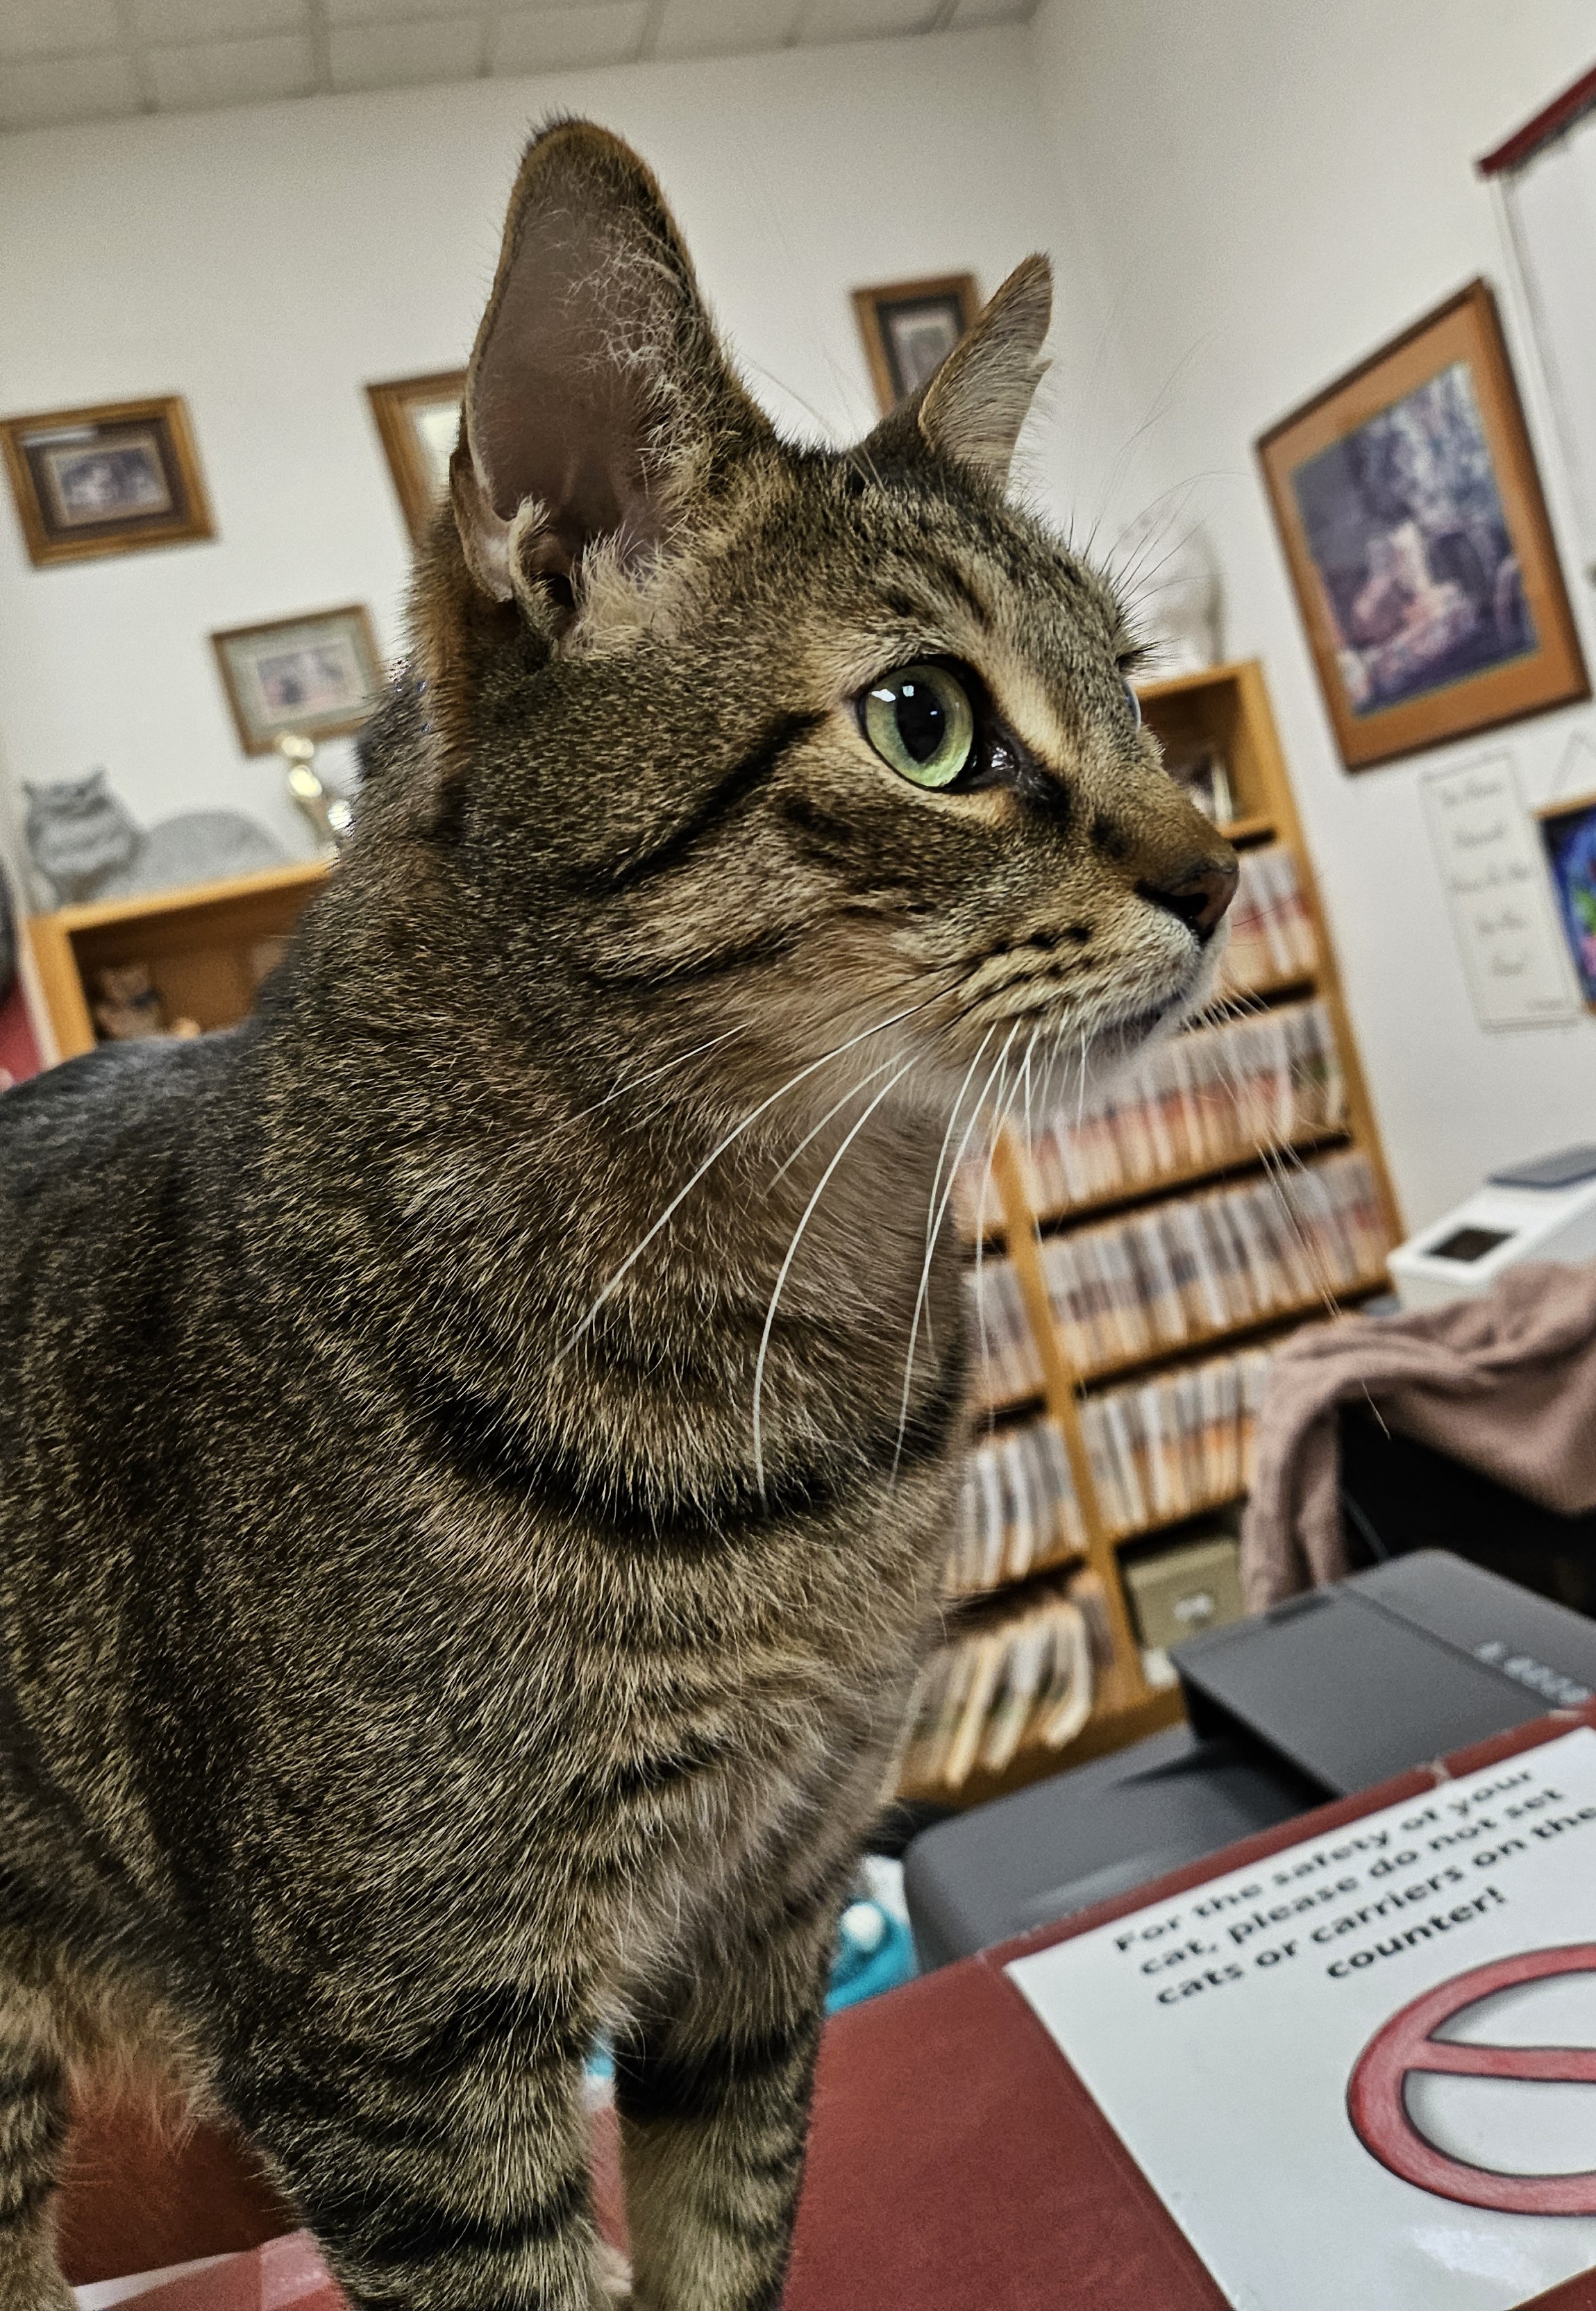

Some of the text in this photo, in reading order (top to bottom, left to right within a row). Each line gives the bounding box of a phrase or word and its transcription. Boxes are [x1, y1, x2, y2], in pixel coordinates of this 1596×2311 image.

[1114, 1770, 1533, 1953] For the safety of your
[1140, 1788, 1565, 1976] cat, please do not set
[1155, 1806, 1596, 2006] cats or carriers on the
[1325, 1884, 1508, 1980] counter!
